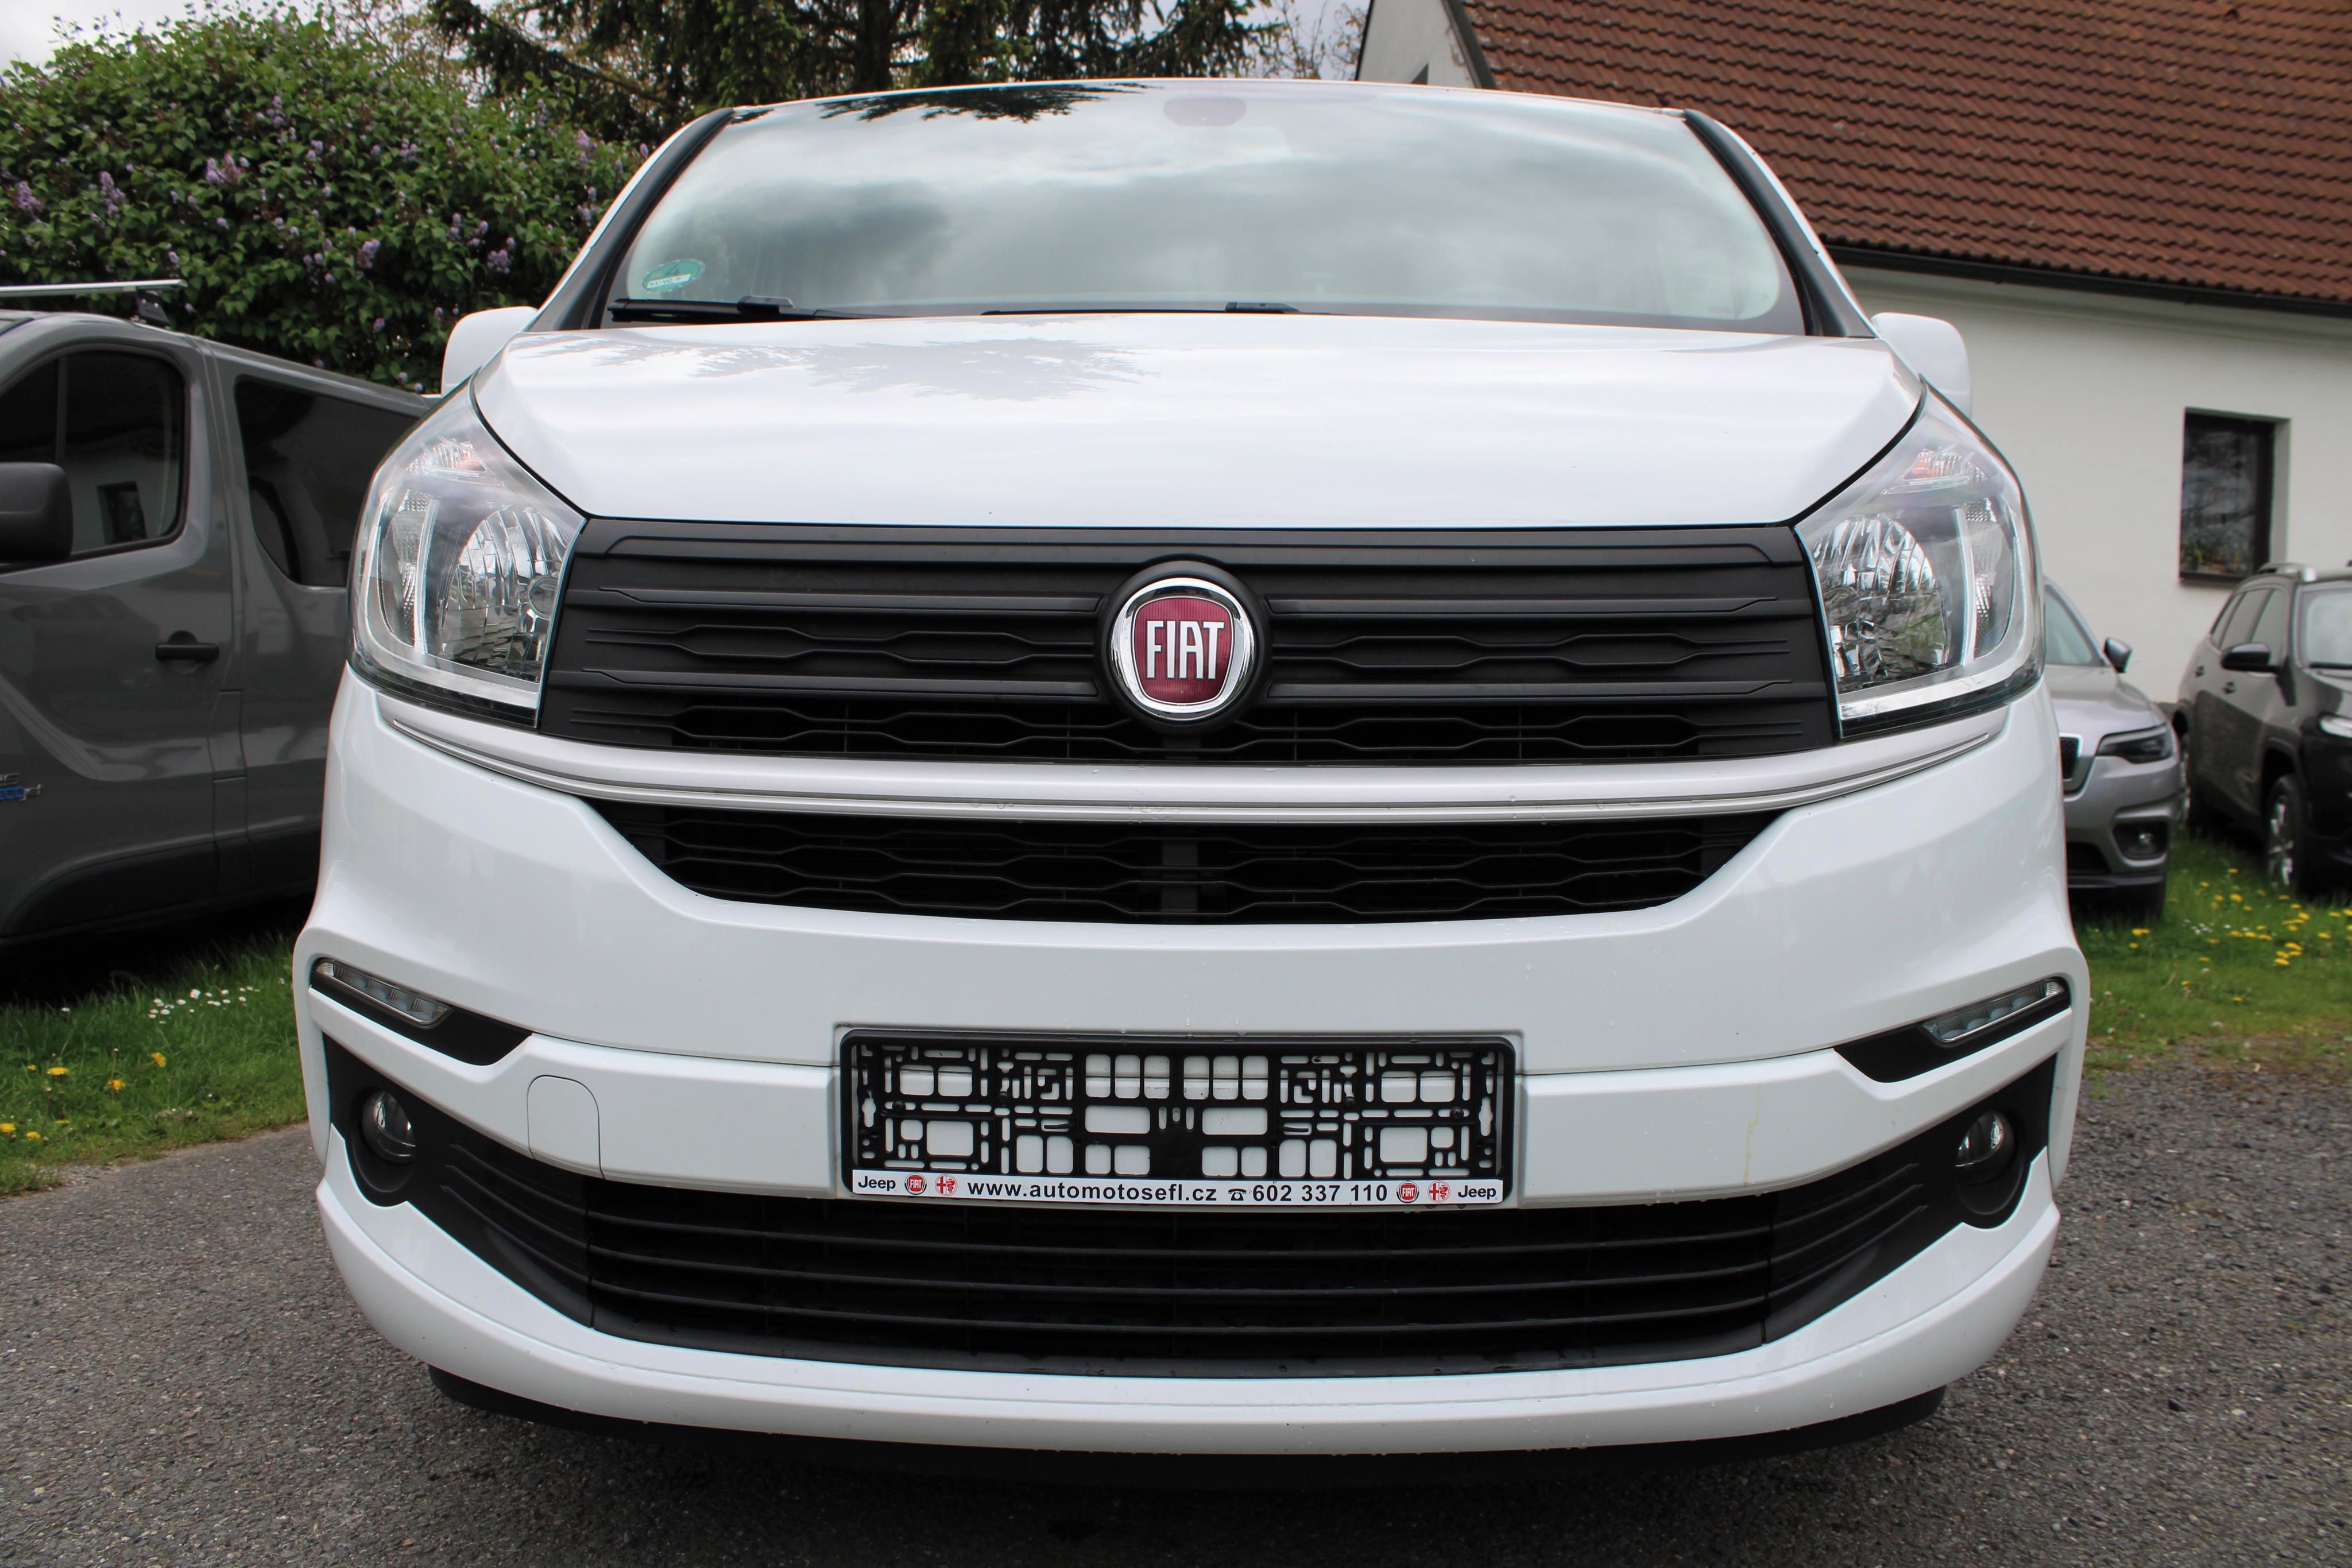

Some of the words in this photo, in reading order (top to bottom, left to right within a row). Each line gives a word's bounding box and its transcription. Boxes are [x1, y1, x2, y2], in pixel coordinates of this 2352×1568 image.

[1147, 621, 1225, 679] FIAT
[858, 1176, 896, 1191] Jeep
[968, 1182, 1217, 1201] www.automotosefl.cz
[1252, 1184, 1292, 1201] 602
[1301, 1184, 1340, 1201] 337
[1351, 1184, 1388, 1201] 110
[1458, 1185, 1496, 1199] Jeep
